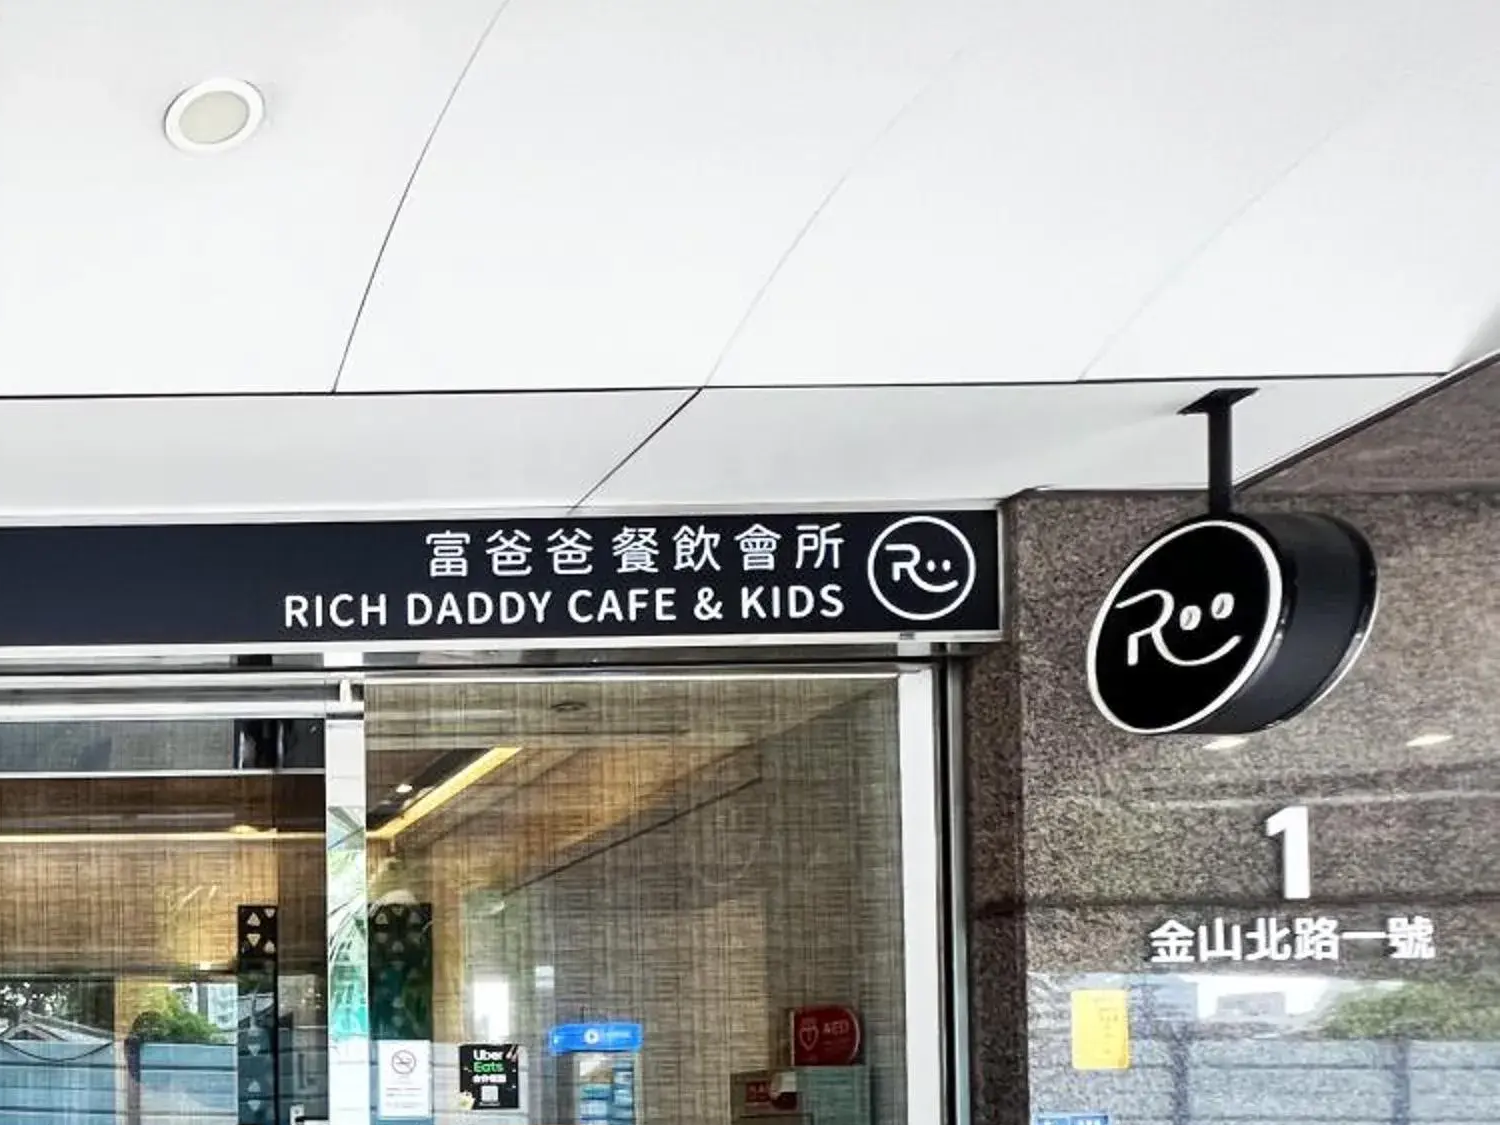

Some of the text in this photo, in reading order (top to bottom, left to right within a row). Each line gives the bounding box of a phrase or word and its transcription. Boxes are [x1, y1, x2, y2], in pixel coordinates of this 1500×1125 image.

[425, 521, 845, 577] 富爸爸餐飲會所
[284, 583, 844, 628] RICH DADDY CAFE & KIDS
[1266, 806, 1311, 899] 1
[1149, 915, 1437, 963] 金山北路一號
[473, 1049, 504, 1061] Uber
[473, 1061, 505, 1073] Eats
